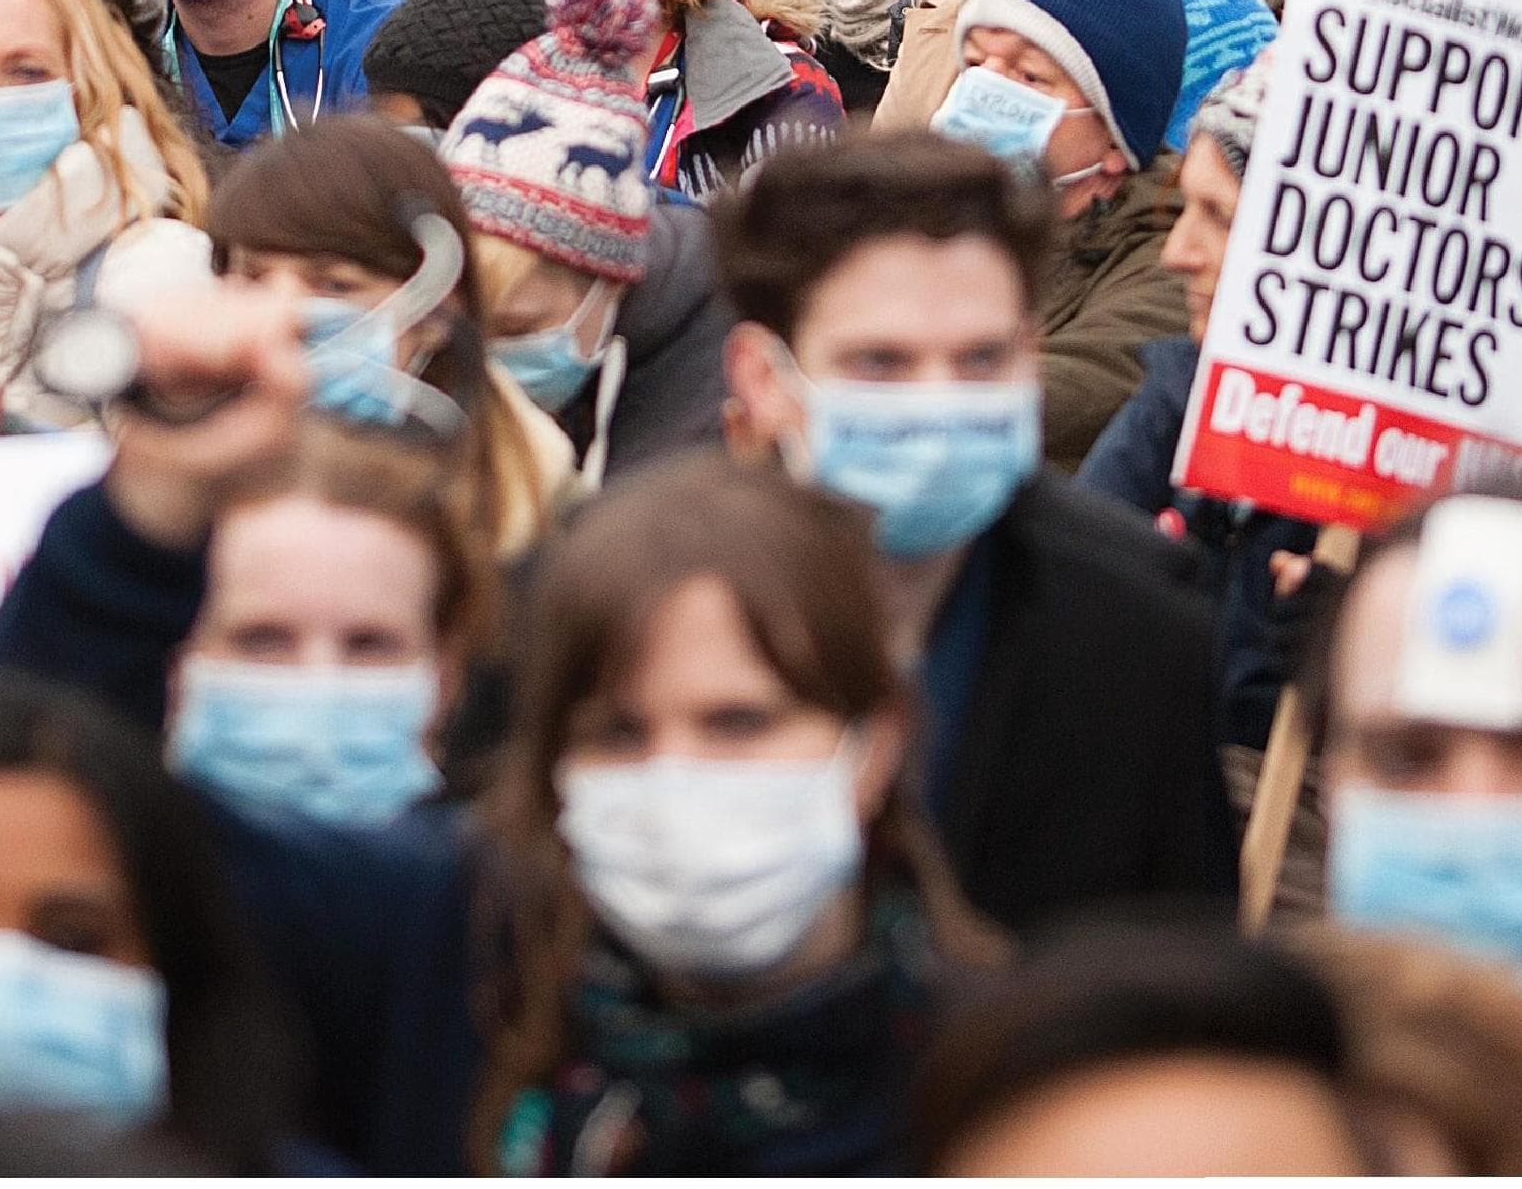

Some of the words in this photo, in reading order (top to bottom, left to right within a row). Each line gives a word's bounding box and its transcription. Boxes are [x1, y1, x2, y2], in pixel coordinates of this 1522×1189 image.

[1280, 92, 1502, 222] JUNIOR
[1244, 269, 1499, 408] STRIKES
[1209, 367, 1377, 470] Defend
[1375, 425, 1450, 488] our
